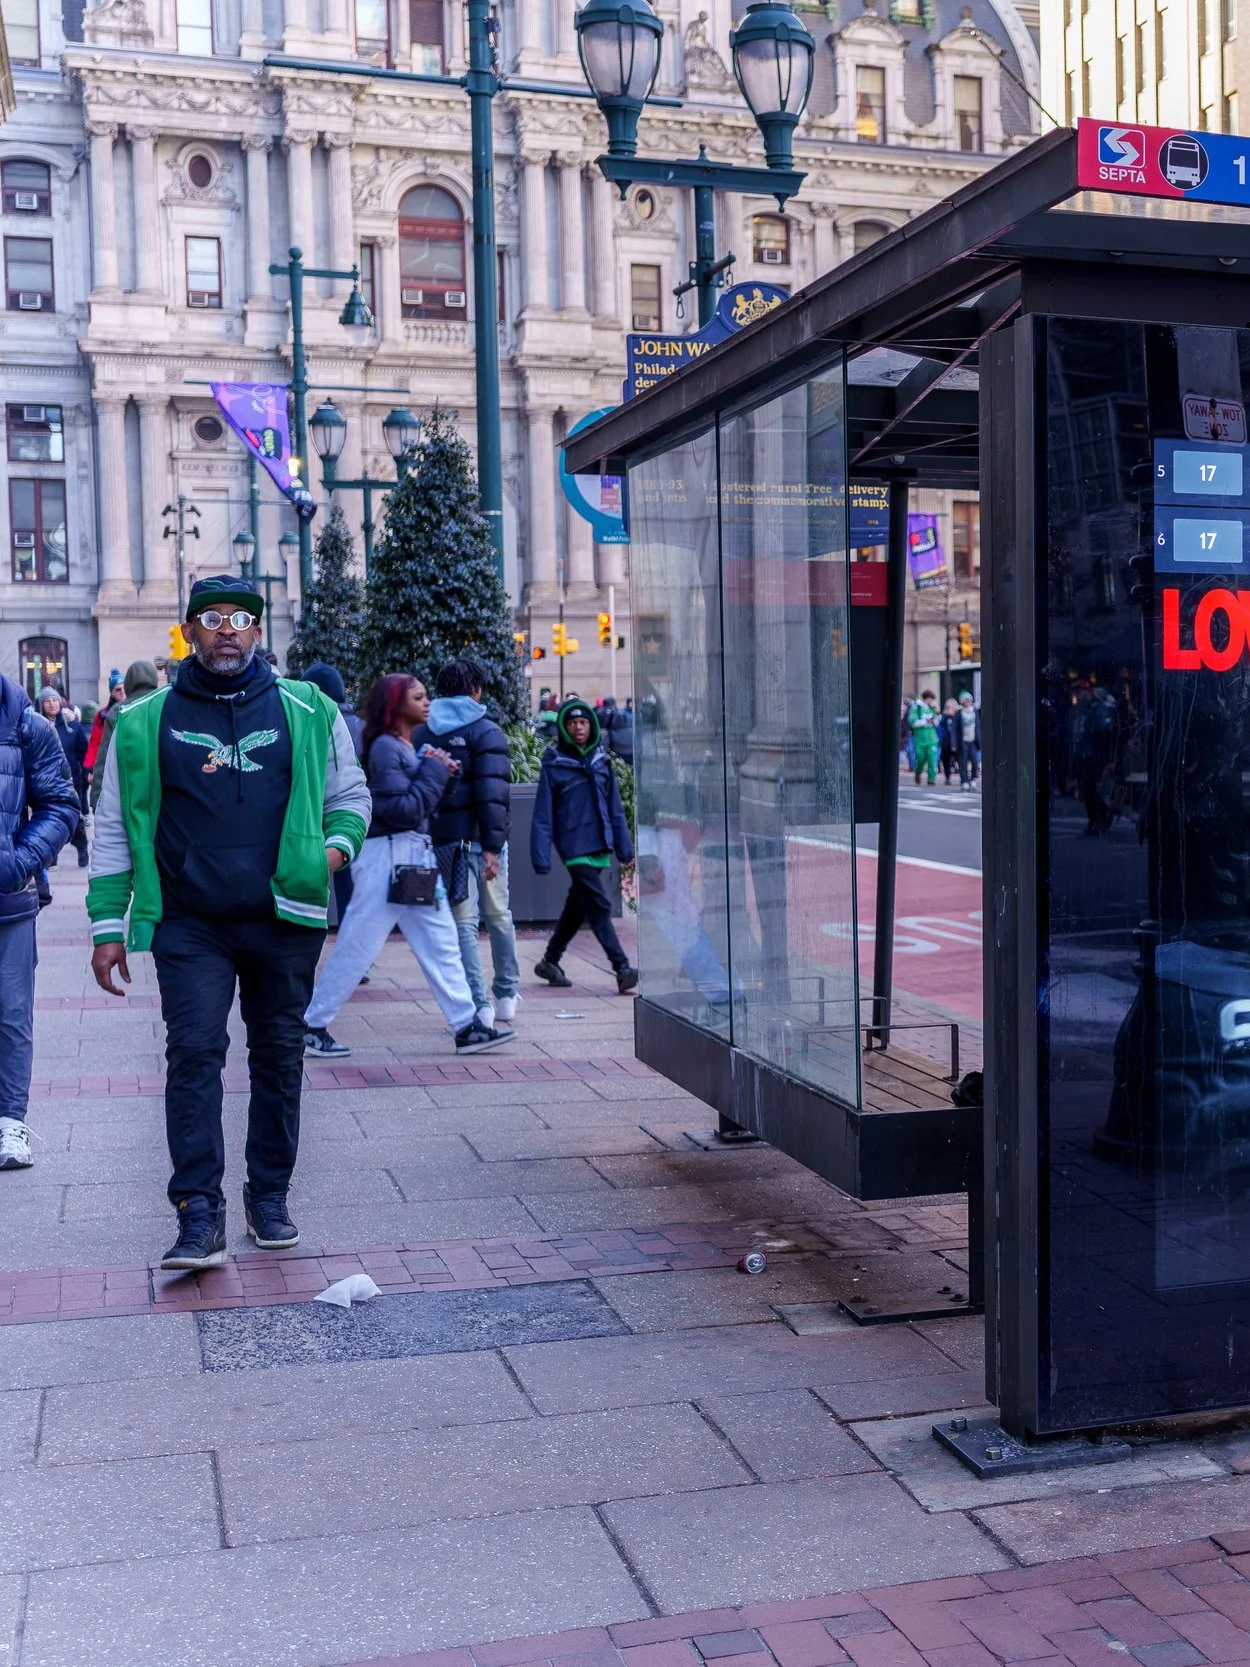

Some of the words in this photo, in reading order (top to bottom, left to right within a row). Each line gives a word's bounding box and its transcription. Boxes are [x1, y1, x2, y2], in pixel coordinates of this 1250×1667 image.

[1098, 167, 1146, 184] SEPTA
[633, 339, 683, 356] JOHN
[685, 342, 716, 357] WA
[1157, 465, 1166, 478] 5
[1199, 464, 1217, 482] 17
[852, 497, 889, 511] stamp.
[1157, 533, 1166, 546] 6
[1199, 532, 1217, 549] 17
